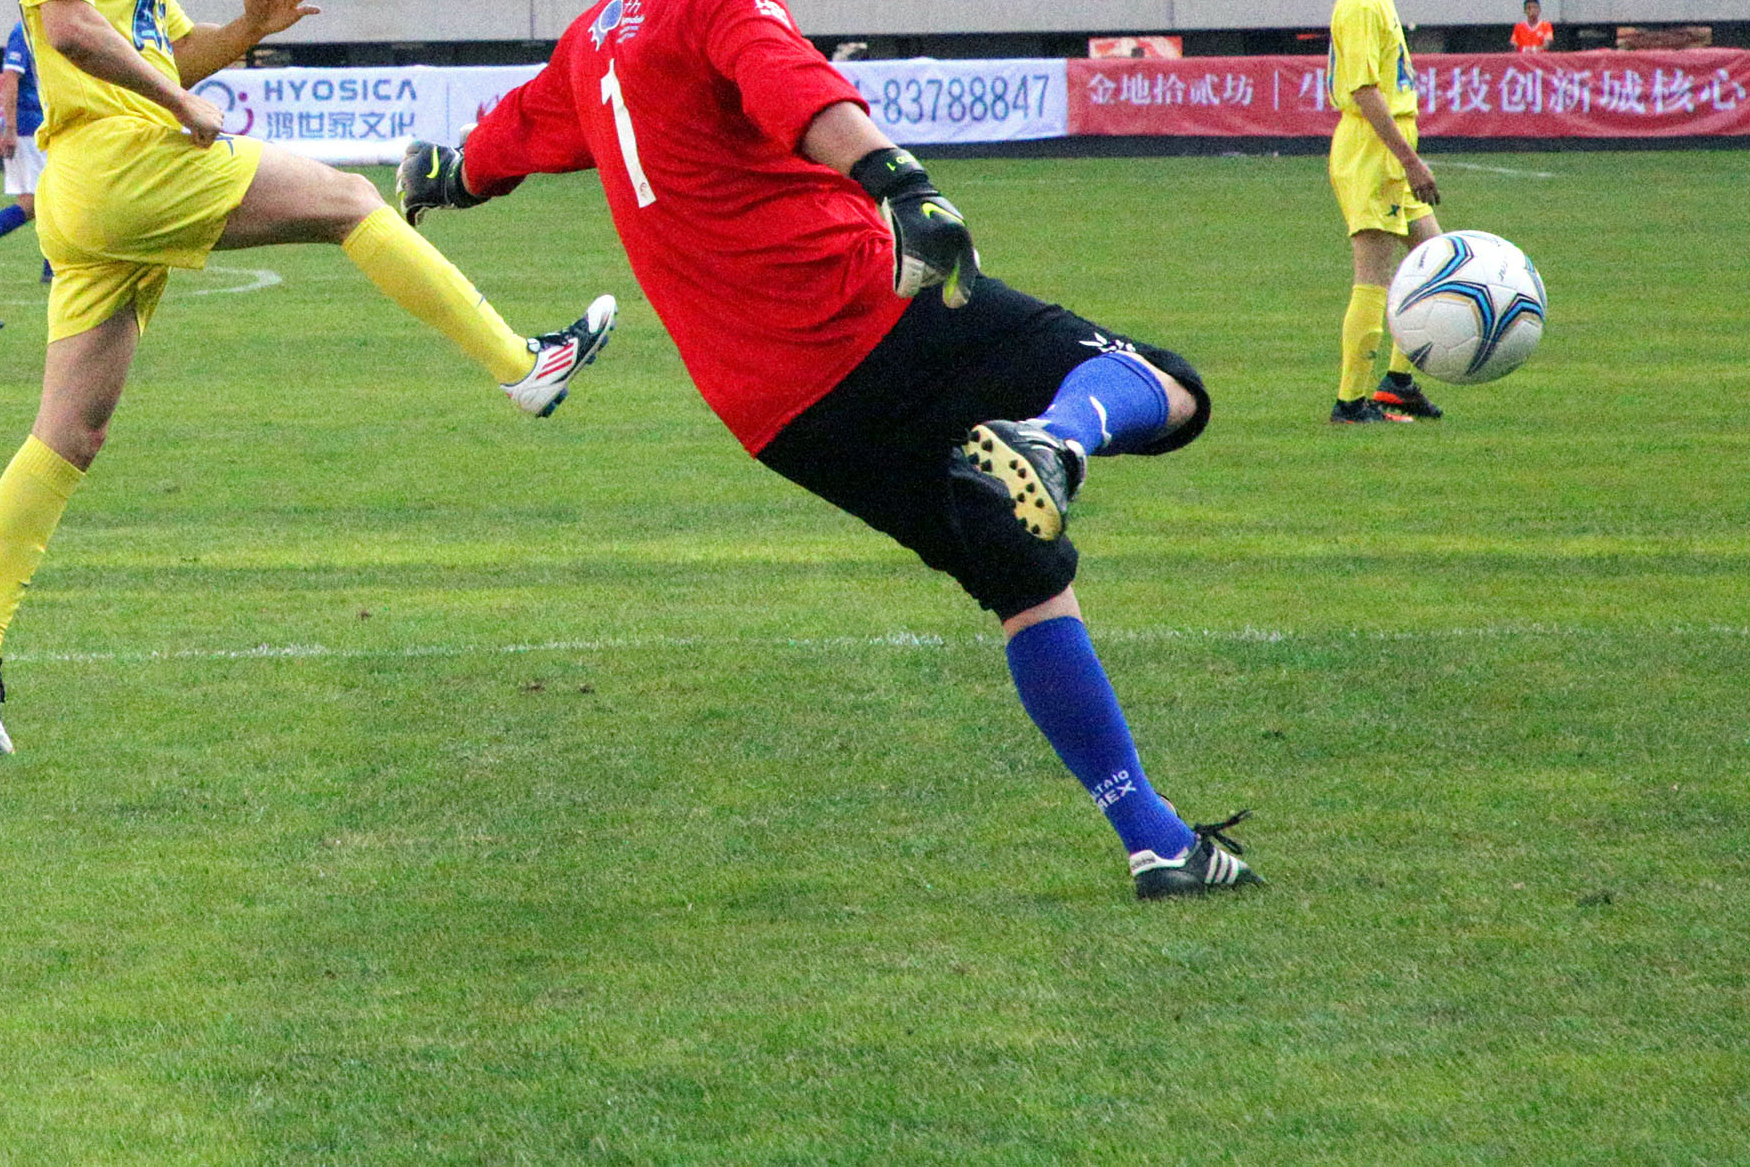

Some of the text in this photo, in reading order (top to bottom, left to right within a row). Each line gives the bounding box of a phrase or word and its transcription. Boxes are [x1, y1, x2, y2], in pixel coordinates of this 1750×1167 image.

[264, 78, 418, 102] HYOSICA
[855, 73, 1050, 125] -83788847
[1088, 71, 1254, 107] 金地拾贰坊
[265, 110, 416, 140] 鸿世家文化
[600, 57, 658, 209] 1
